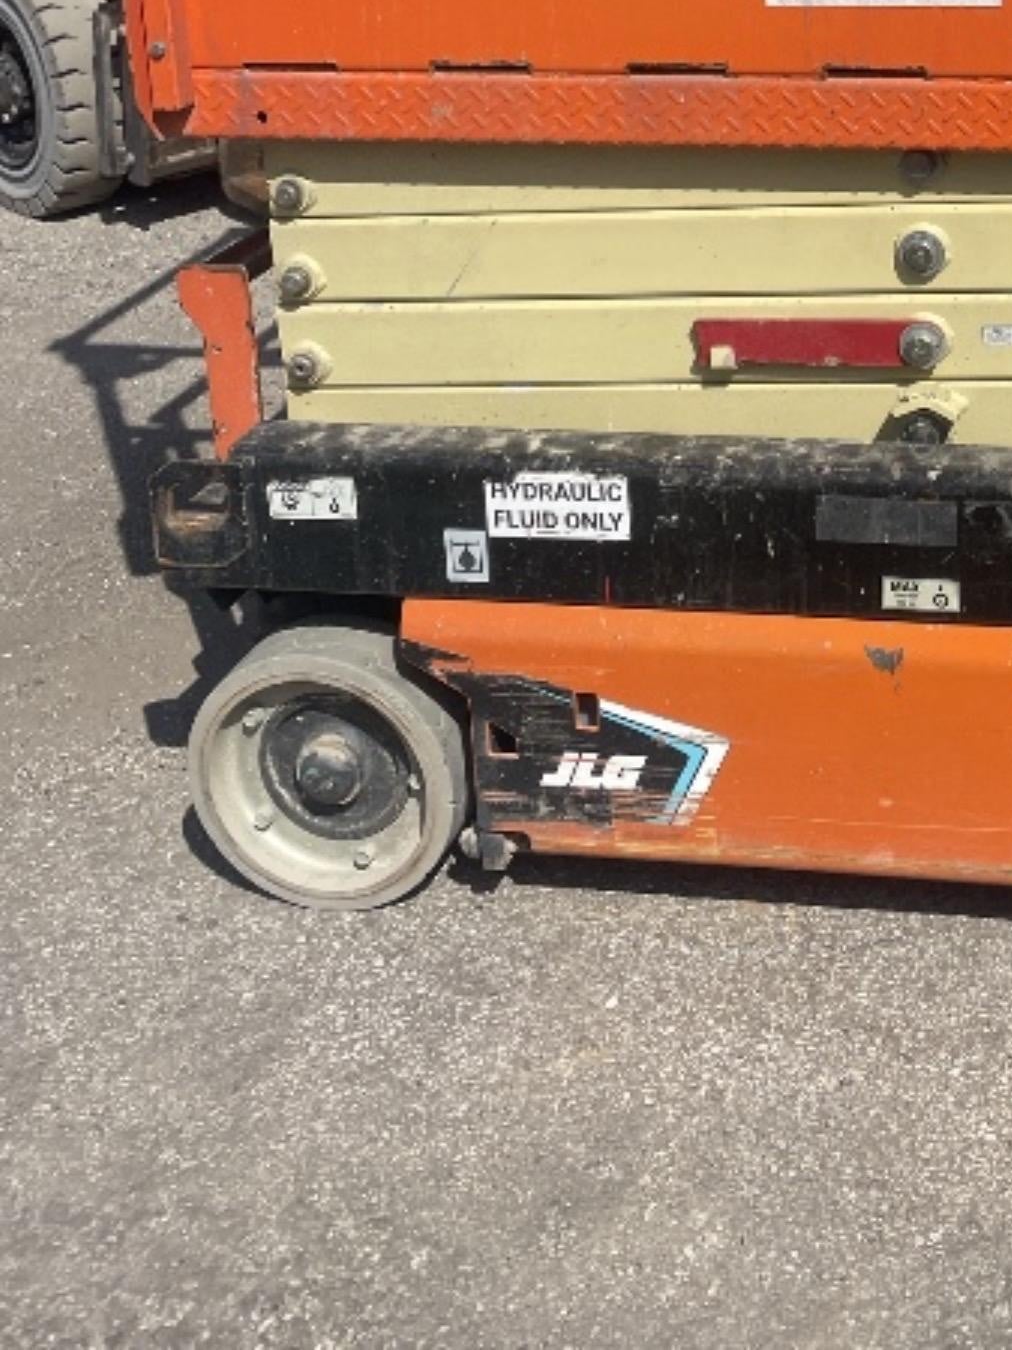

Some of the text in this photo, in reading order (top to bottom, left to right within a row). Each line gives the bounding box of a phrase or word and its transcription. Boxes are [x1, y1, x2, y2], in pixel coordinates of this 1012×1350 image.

[490, 481, 623, 502] HYDRAULIC
[494, 509, 624, 532] FLUID ONLY
[539, 752, 648, 789] JLG
